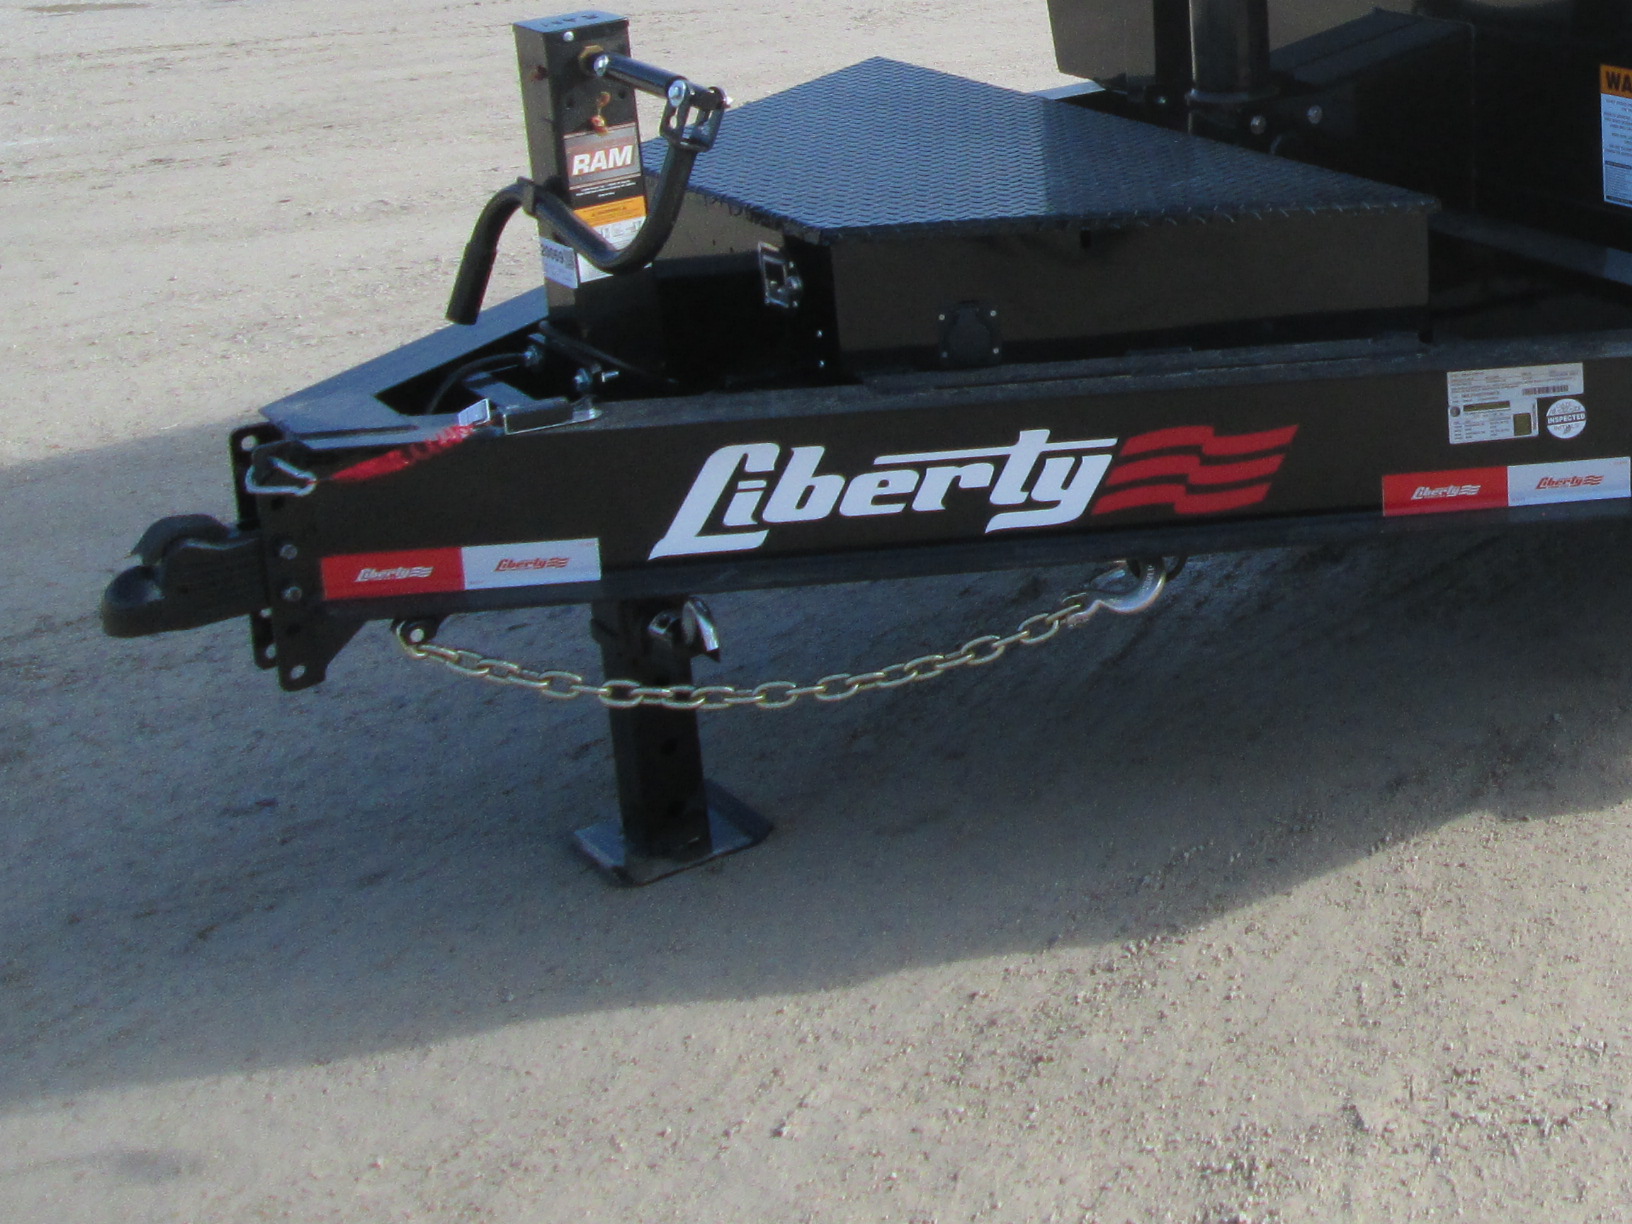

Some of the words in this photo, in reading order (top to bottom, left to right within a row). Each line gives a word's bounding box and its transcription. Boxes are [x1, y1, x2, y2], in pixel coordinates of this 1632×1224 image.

[572, 144, 633, 176] RAM
[1547, 412, 1586, 424] INSPECTED
[648, 428, 1118, 561] Liberty
[1411, 484, 1461, 501] Liberty
[1535, 475, 1584, 490] Liberty
[354, 566, 410, 583] Liberty
[493, 557, 547, 572] Liberty
